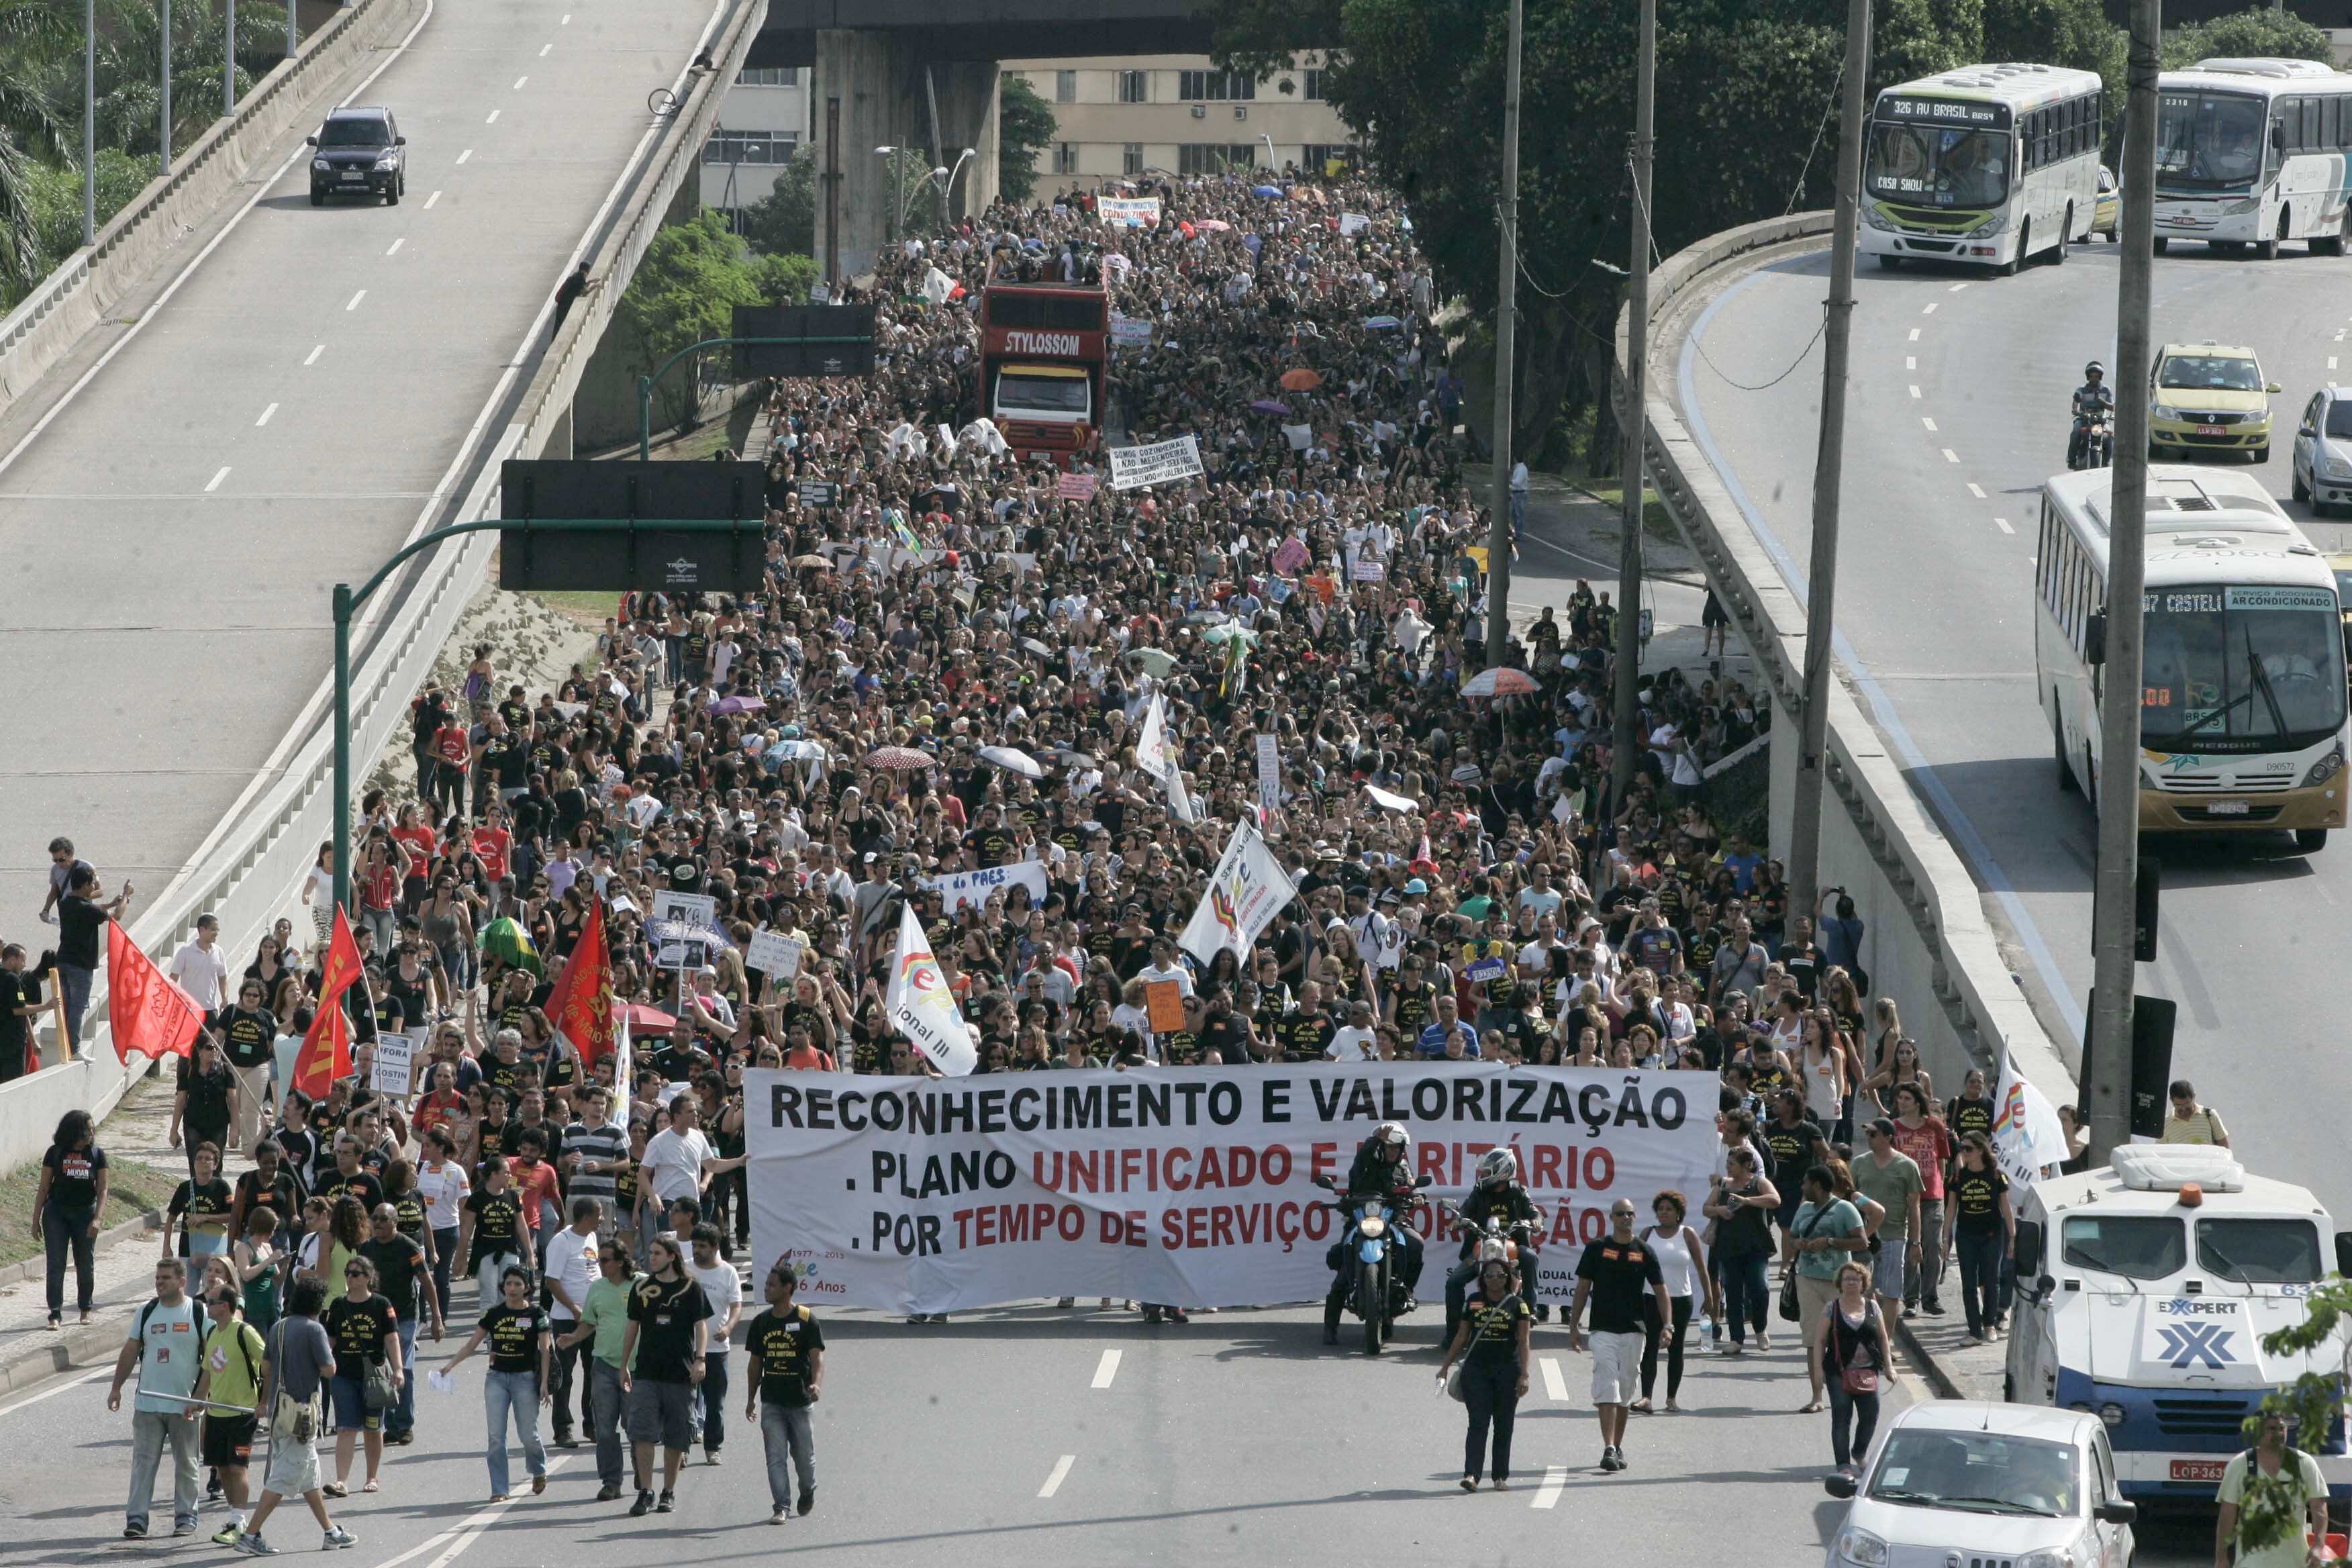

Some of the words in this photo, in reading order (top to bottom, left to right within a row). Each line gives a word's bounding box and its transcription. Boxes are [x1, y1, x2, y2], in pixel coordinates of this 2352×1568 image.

[1895, 101, 1911, 114] 326
[1916, 103, 1930, 115] AV
[1933, 105, 1969, 120] BRASIL
[1878, 177, 1897, 190] CASA
[1900, 179, 1922, 192] SHOW
[1005, 332, 1080, 356] STYLOSSOM
[1114, 450, 1136, 459] SOMOS
[1139, 440, 1185, 458] COZINHEIRAS
[1122, 458, 1136, 468] NÃO
[1140, 448, 1188, 466] MERENDEIRAS
[1132, 473, 1157, 484] DIZENDO
[2231, 597, 2247, 607] AR
[2247, 597, 2332, 608] CONDICIONADO
[2266, 763, 2296, 771] D90572
[577, 1018, 602, 1044] Maio
[771, 1080, 1242, 1135] RECONHECIMENTO
[1263, 1080, 1291, 1123] E
[1310, 1075, 1687, 1137] VALORIZAÇÃO
[66, 1168, 89, 1177] MUDAR
[873, 1150, 1016, 1199] PLANO
[1032, 1145, 1291, 1193] UNIFICADO
[1310, 1142, 1337, 1184] E
[873, 1212, 941, 1257] POR
[953, 1204, 1085, 1250] TEMPO
[1099, 1210, 1147, 1247] DE
[1161, 1197, 1330, 1253] SERVIÇO
[792, 1250, 814, 1259] 1977
[814, 1281, 846, 1294] Anos
